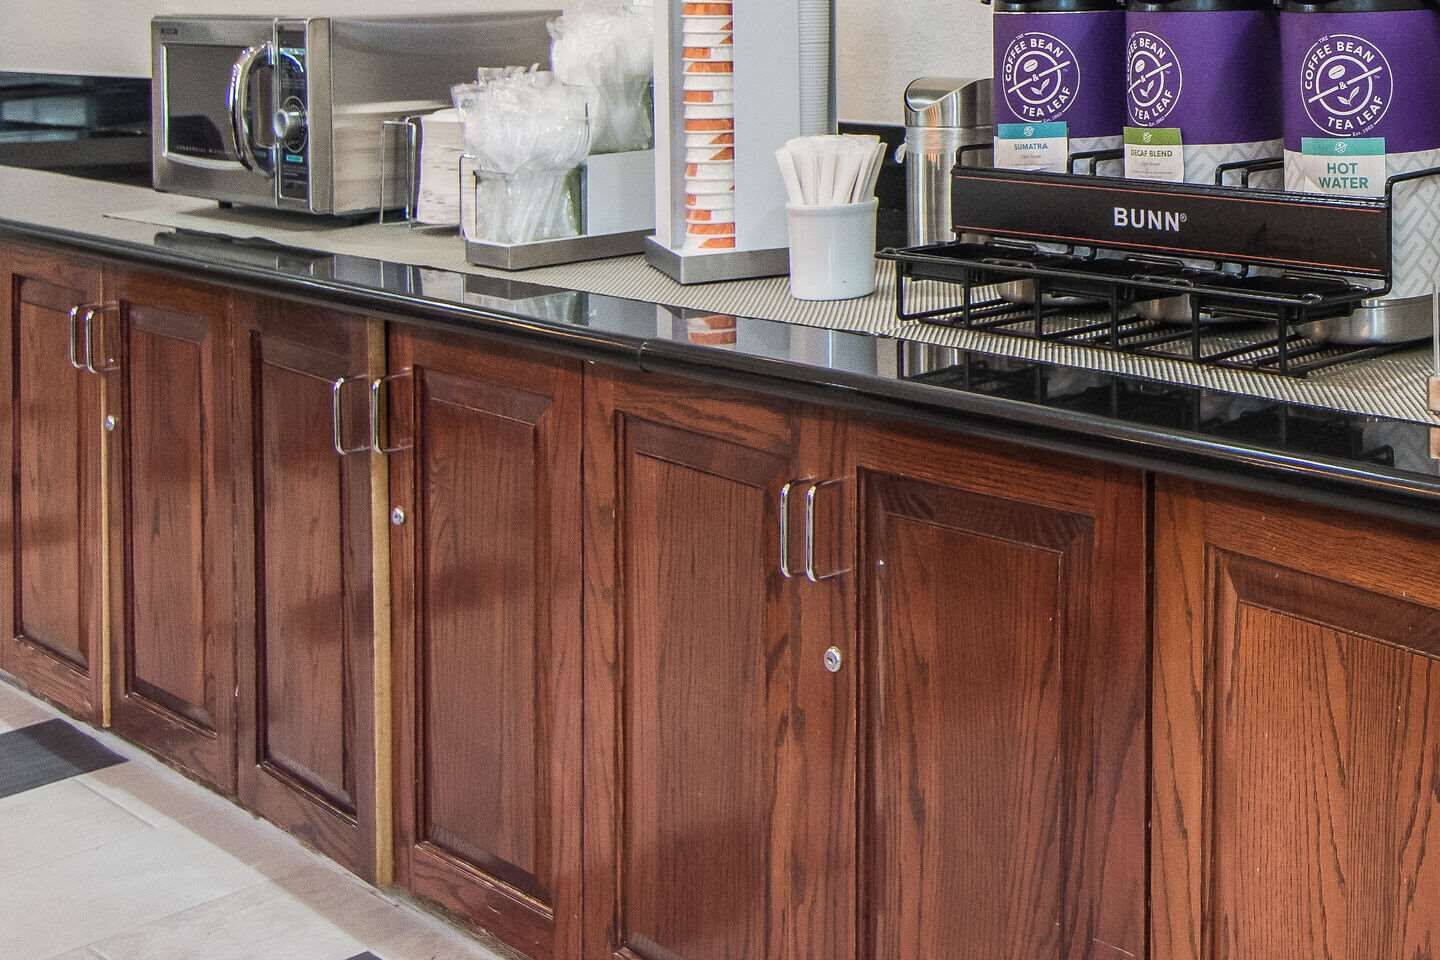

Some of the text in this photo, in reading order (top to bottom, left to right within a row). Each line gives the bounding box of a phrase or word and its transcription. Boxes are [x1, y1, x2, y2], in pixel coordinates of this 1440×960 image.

[1005, 39, 1063, 82] COFFEE BEAN
[1140, 38, 1166, 59] BEAN
[1305, 41, 1375, 90] COFFEE BEAN
[1023, 86, 1070, 117] TEA LEAF
[1134, 89, 1173, 120] TEA LEAF
[1328, 96, 1383, 130] TEA LEAF
[1319, 177, 1369, 189] WATER
[1327, 162, 1358, 175] HOT
